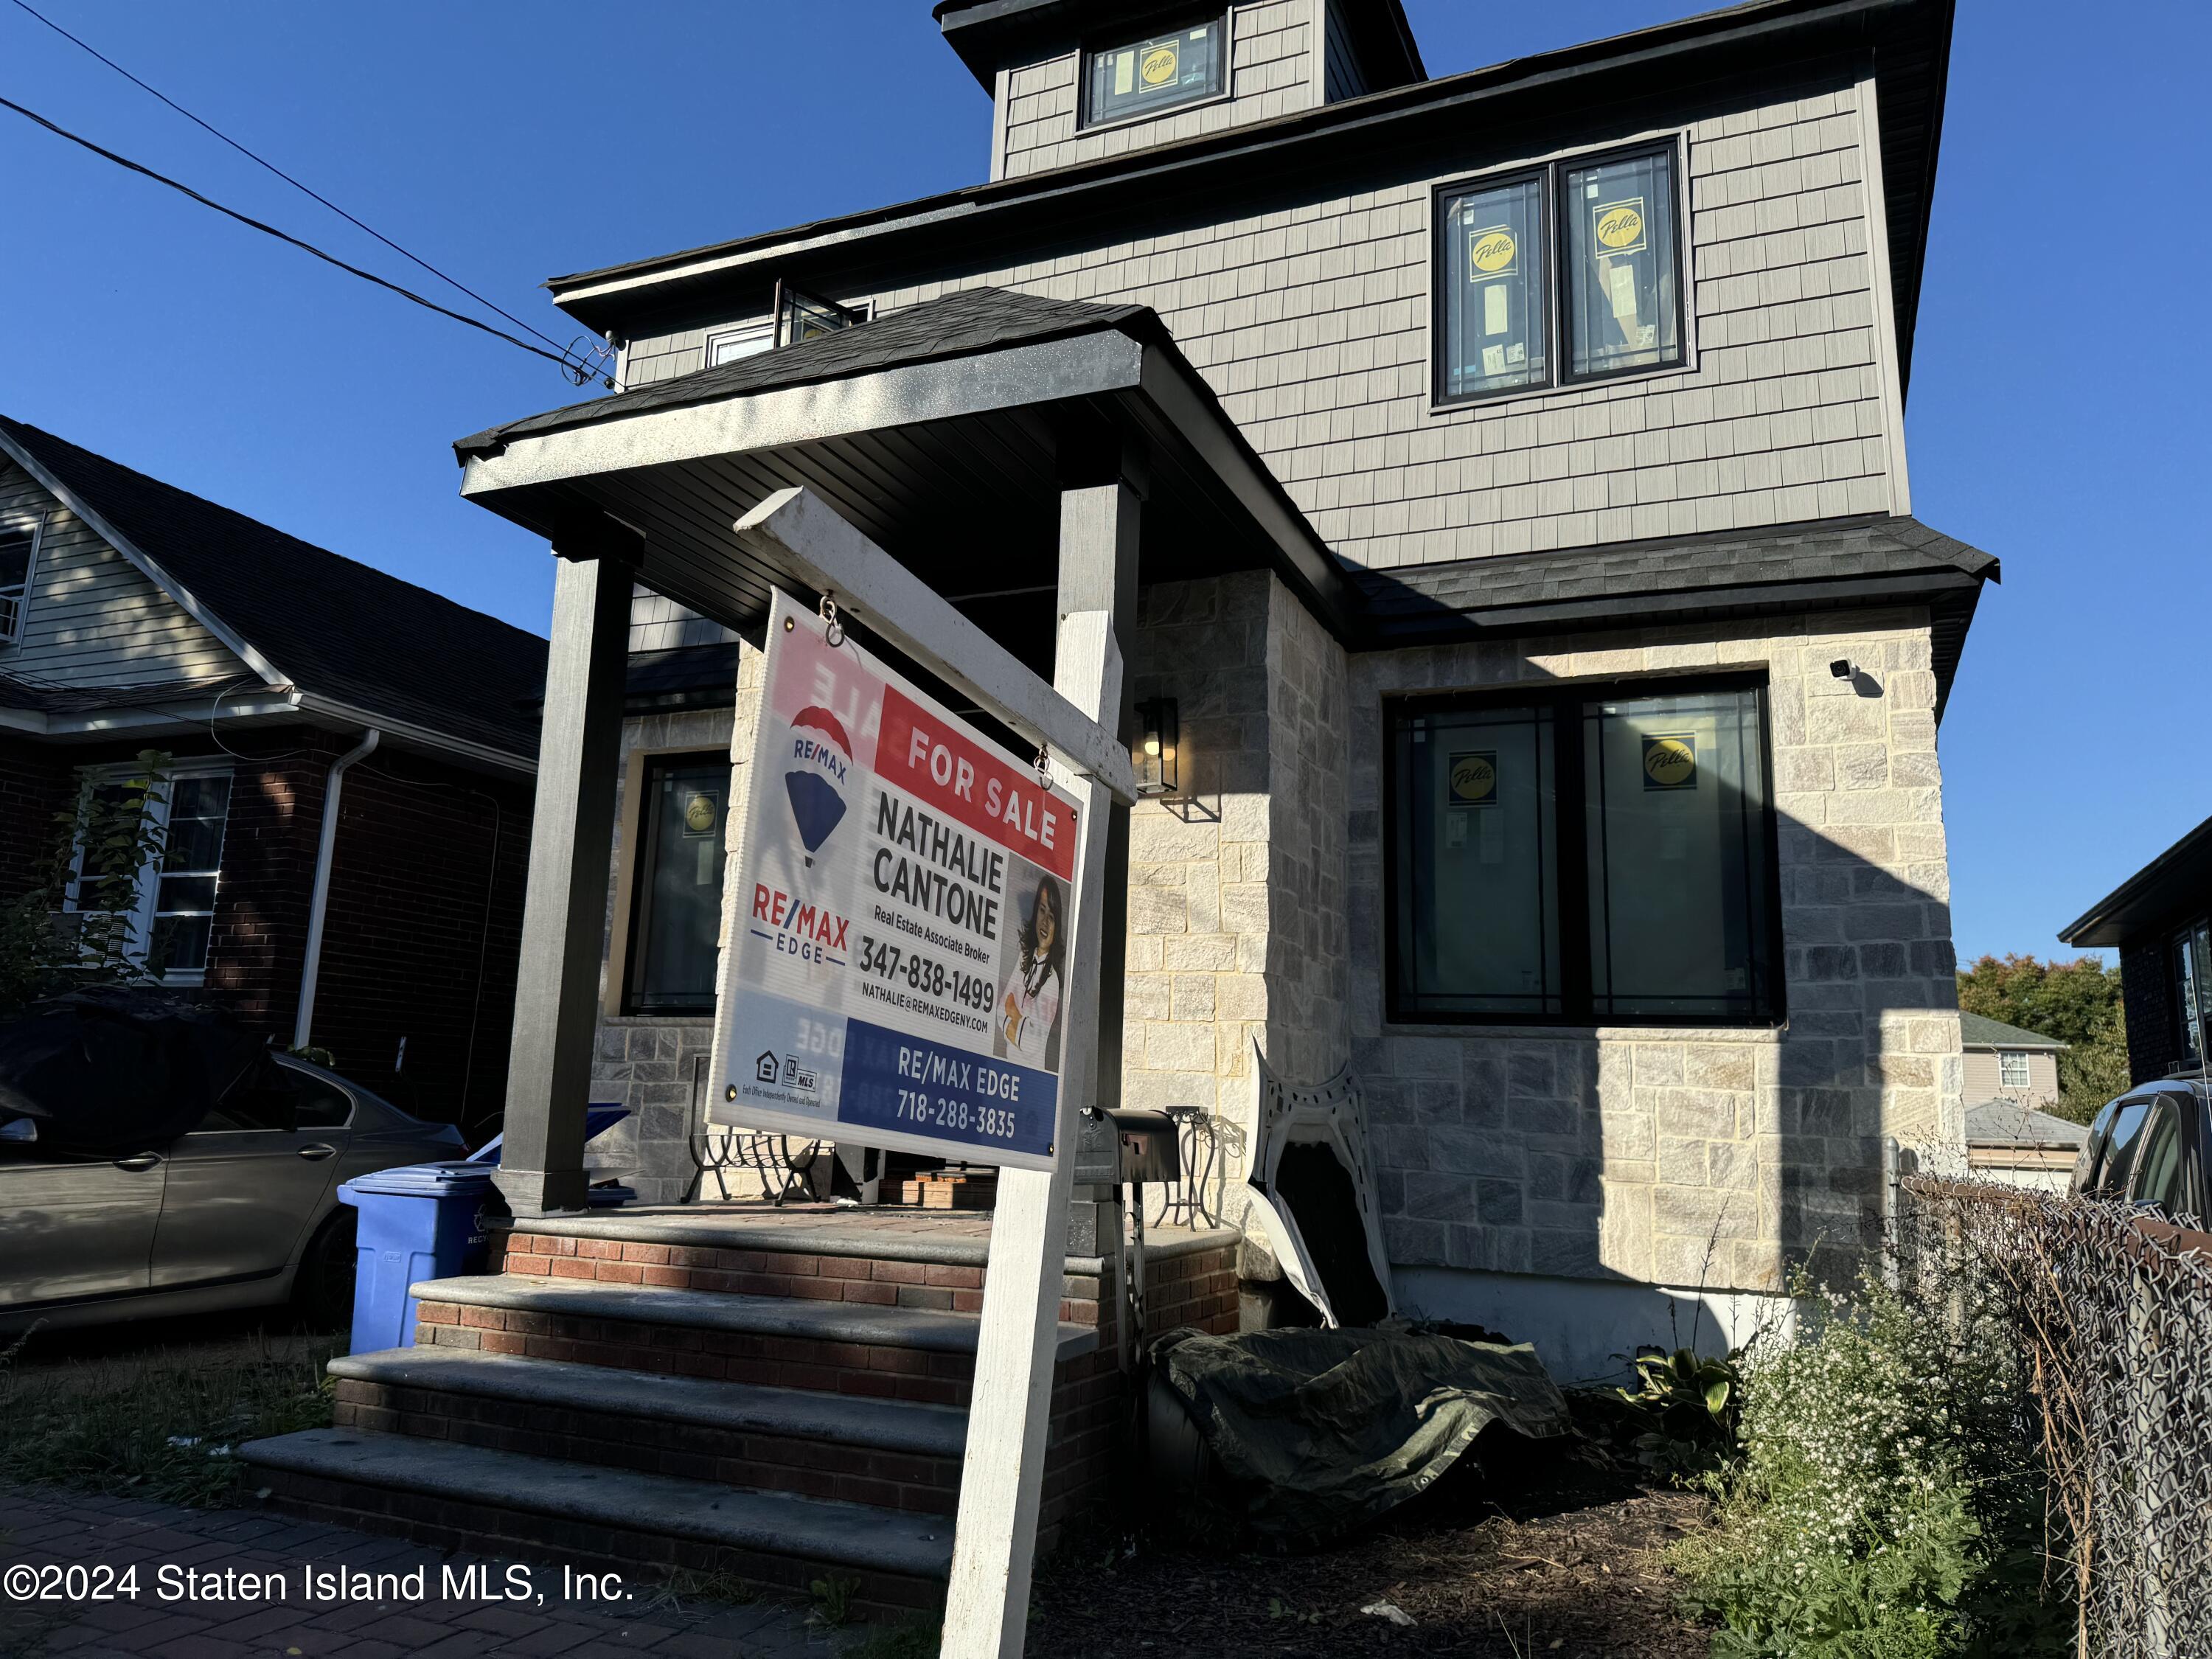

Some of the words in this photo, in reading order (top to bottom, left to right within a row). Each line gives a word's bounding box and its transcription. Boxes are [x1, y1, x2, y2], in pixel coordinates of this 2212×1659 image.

[1144, 55, 1173, 77] Pella
[1600, 211, 1639, 240] Pella
[1475, 234, 1512, 264] Pella
[794, 740, 846, 785] RE/MAX
[1453, 766, 1492, 789] Pella
[1648, 748, 1690, 773] Pella
[908, 726, 975, 803] FOR
[984, 777, 1057, 850] SALE
[877, 790, 1004, 894] NATHALIE
[874, 847, 998, 941] CANTONE
[752, 883, 849, 951] RE/MAX
[874, 904, 894, 927] Real
[896, 914, 922, 938] Estate
[924, 926, 963, 954] Associate
[964, 942, 990, 964] Broker
[776, 932, 823, 964] EDGE
[859, 935, 994, 1013] 347-838-1499
[862, 981, 988, 1034] NATHALIE@REMAXEDGENY.COM
[752, 1085, 762, 1097] Office
[798, 1076, 814, 1088] MLS
[897, 1046, 971, 1091] RE/MAX
[976, 1067, 1020, 1102] EDGE
[897, 1088, 1015, 1138] 718-288-3835
[467, 1235, 489, 1245] RECY
